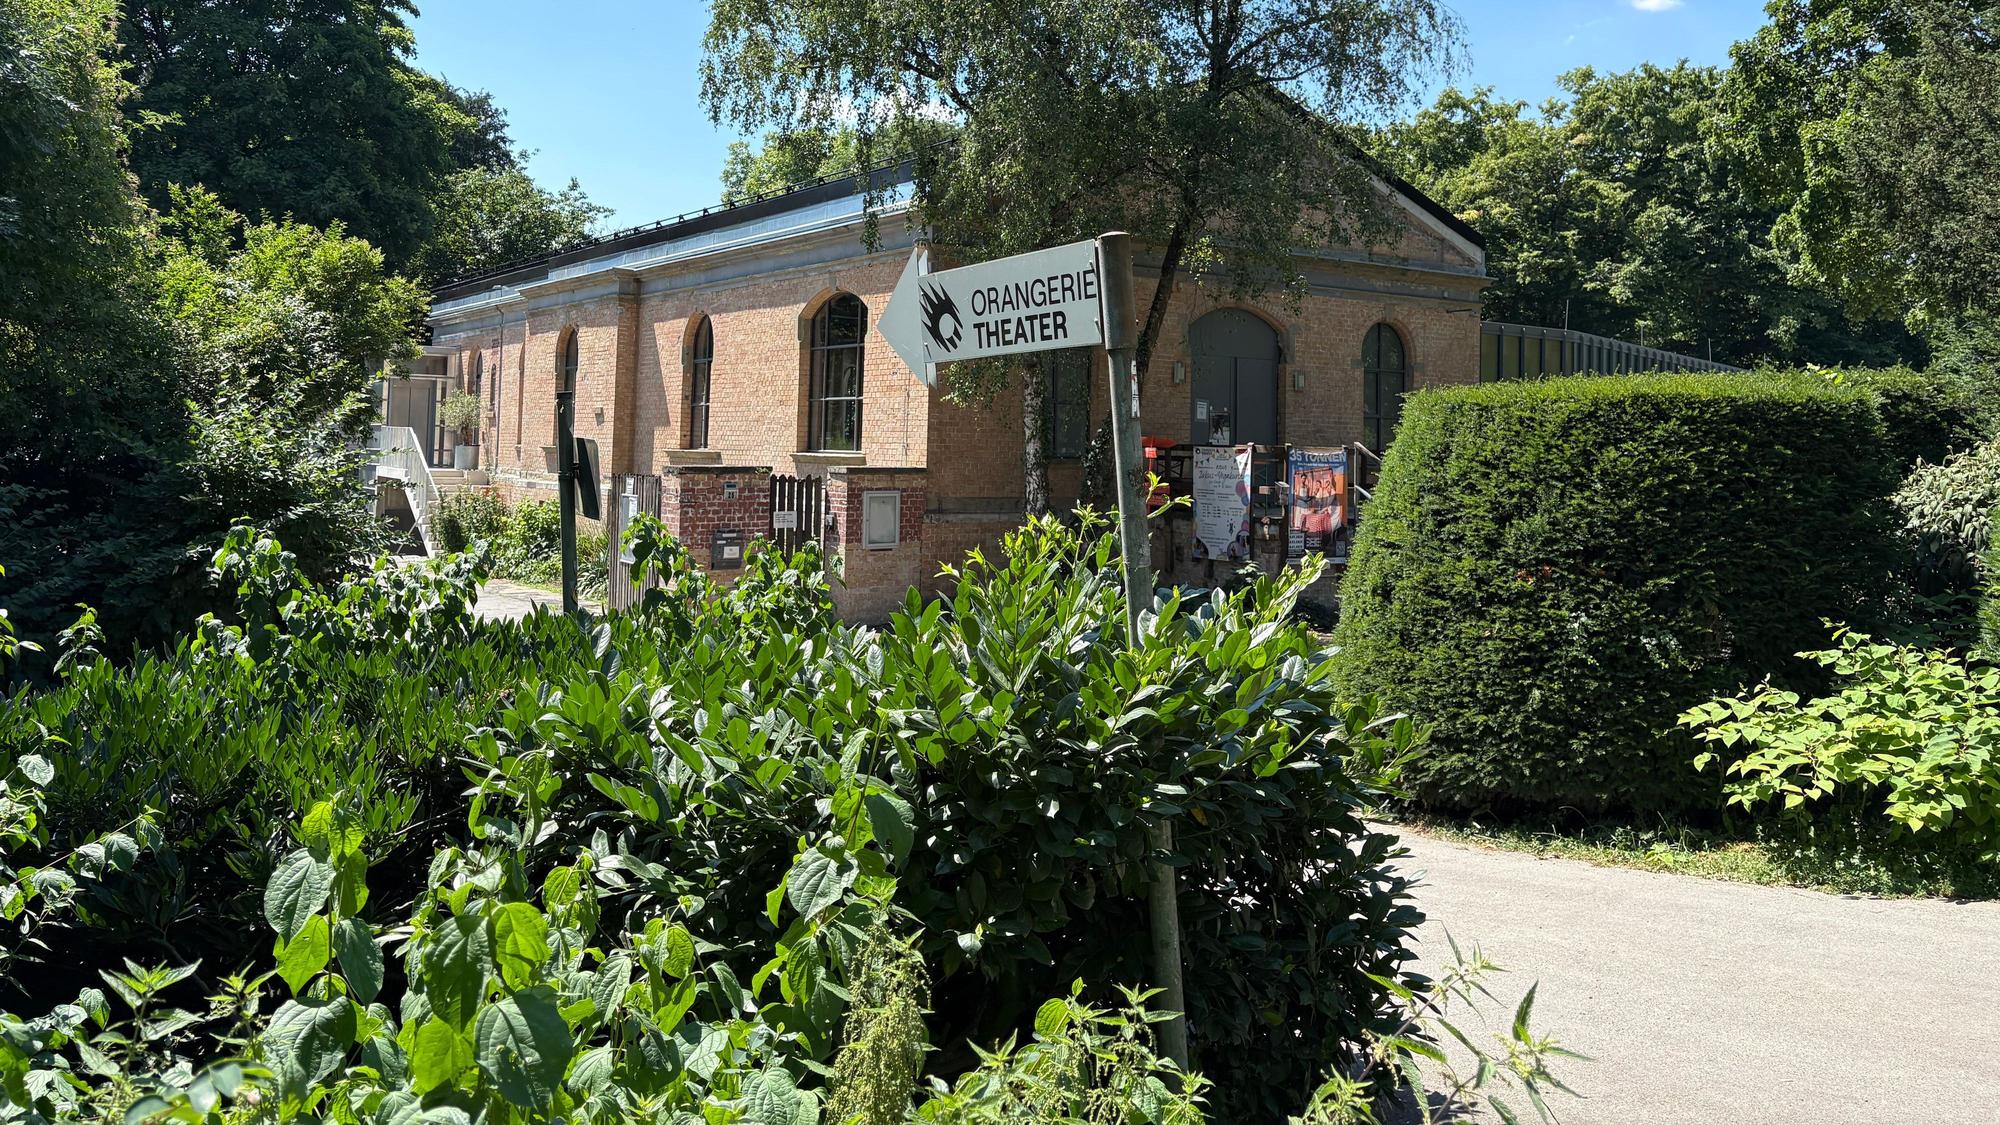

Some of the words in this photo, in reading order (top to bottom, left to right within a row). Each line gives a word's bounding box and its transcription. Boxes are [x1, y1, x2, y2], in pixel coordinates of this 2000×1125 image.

[971, 268, 1098, 317] ORANGERIE
[973, 310, 1068, 349] THEATER
[1289, 449, 1302, 461] 35
[1304, 451, 1347, 462] TONNEN
